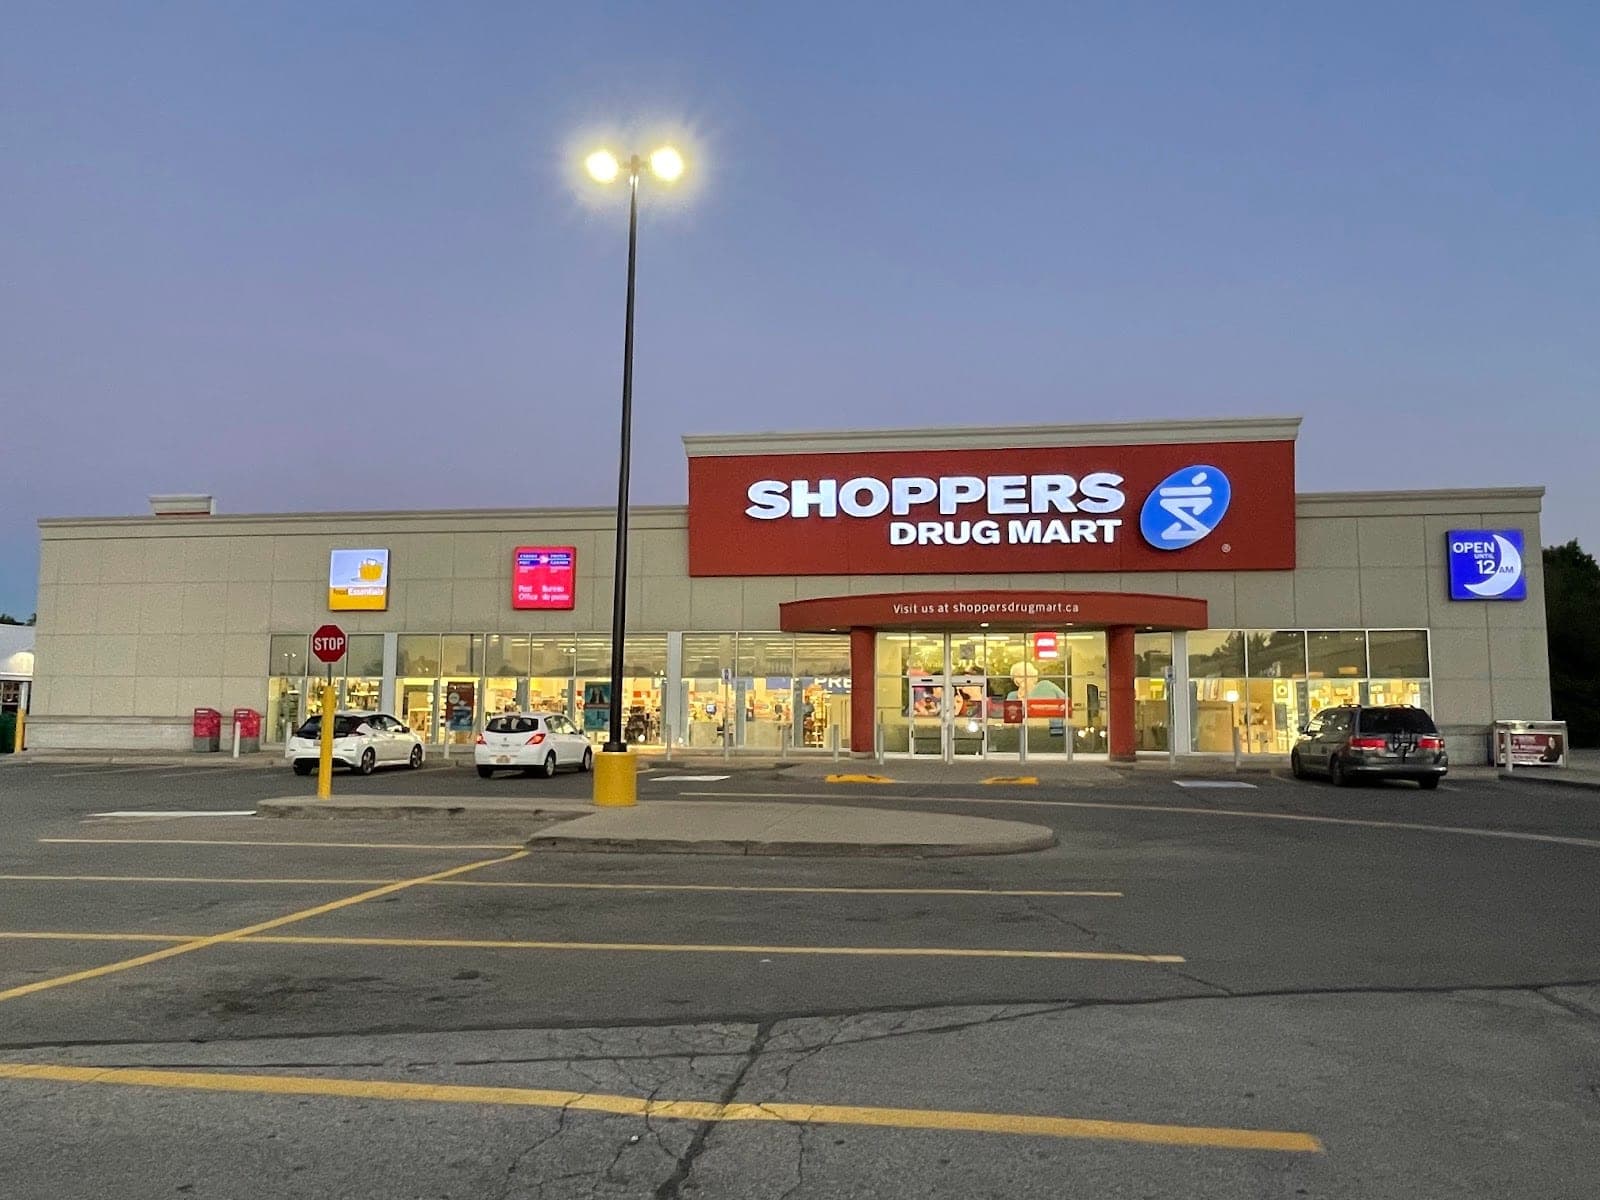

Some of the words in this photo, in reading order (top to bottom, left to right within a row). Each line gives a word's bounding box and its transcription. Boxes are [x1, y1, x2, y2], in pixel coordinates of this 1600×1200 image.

[745, 472, 1126, 520] SHOPPERS
[889, 521, 1000, 545] DRUG
[1008, 519, 1122, 544] MART
[1452, 541, 1495, 554] OPEN
[1476, 559, 1496, 575] 12
[1499, 566, 1514, 574] AM
[893, 603, 918, 615] Visit
[921, 605, 934, 614] us
[937, 603, 950, 614] at
[953, 602, 1080, 615] shoppersdrugmart.ca
[314, 637, 345, 651] STOP
